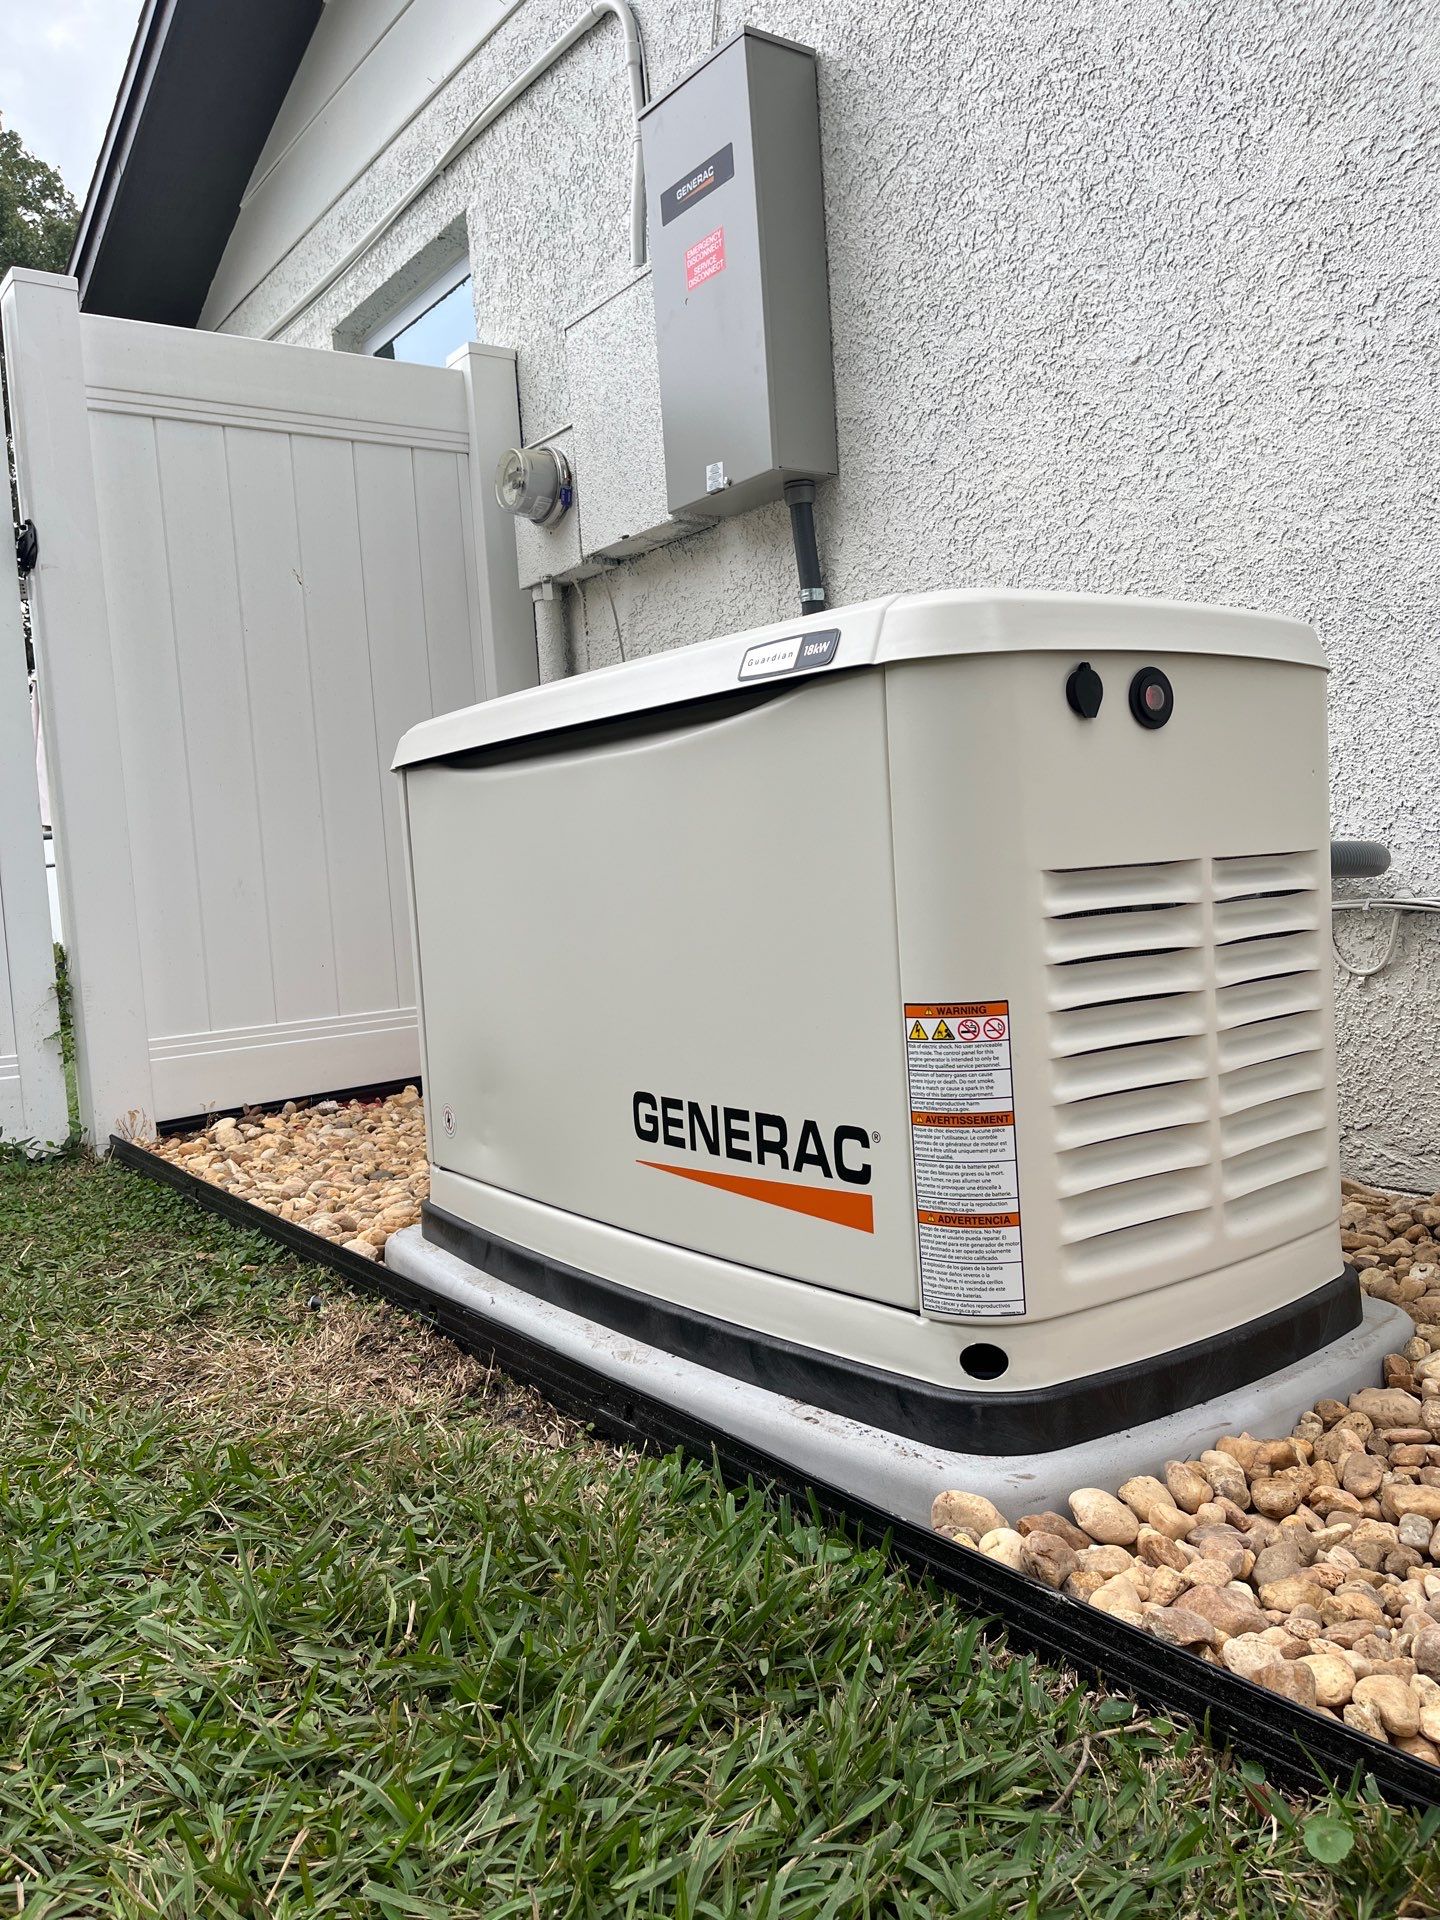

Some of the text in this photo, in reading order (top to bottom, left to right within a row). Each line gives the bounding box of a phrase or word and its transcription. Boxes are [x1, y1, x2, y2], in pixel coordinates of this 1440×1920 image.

[676, 165, 714, 200] GENERAC
[687, 229, 722, 259] EMERGENCY
[687, 239, 722, 268] DISCONNECT
[688, 259, 723, 288] DISCONNECT
[693, 254, 717, 275] SERVICE
[747, 641, 831, 667] Guardian 18kW
[936, 1006, 987, 1015] WARNING
[926, 1114, 1010, 1125] AVERTISSEMENT
[938, 1215, 1011, 1226] ADVERTENCIA
